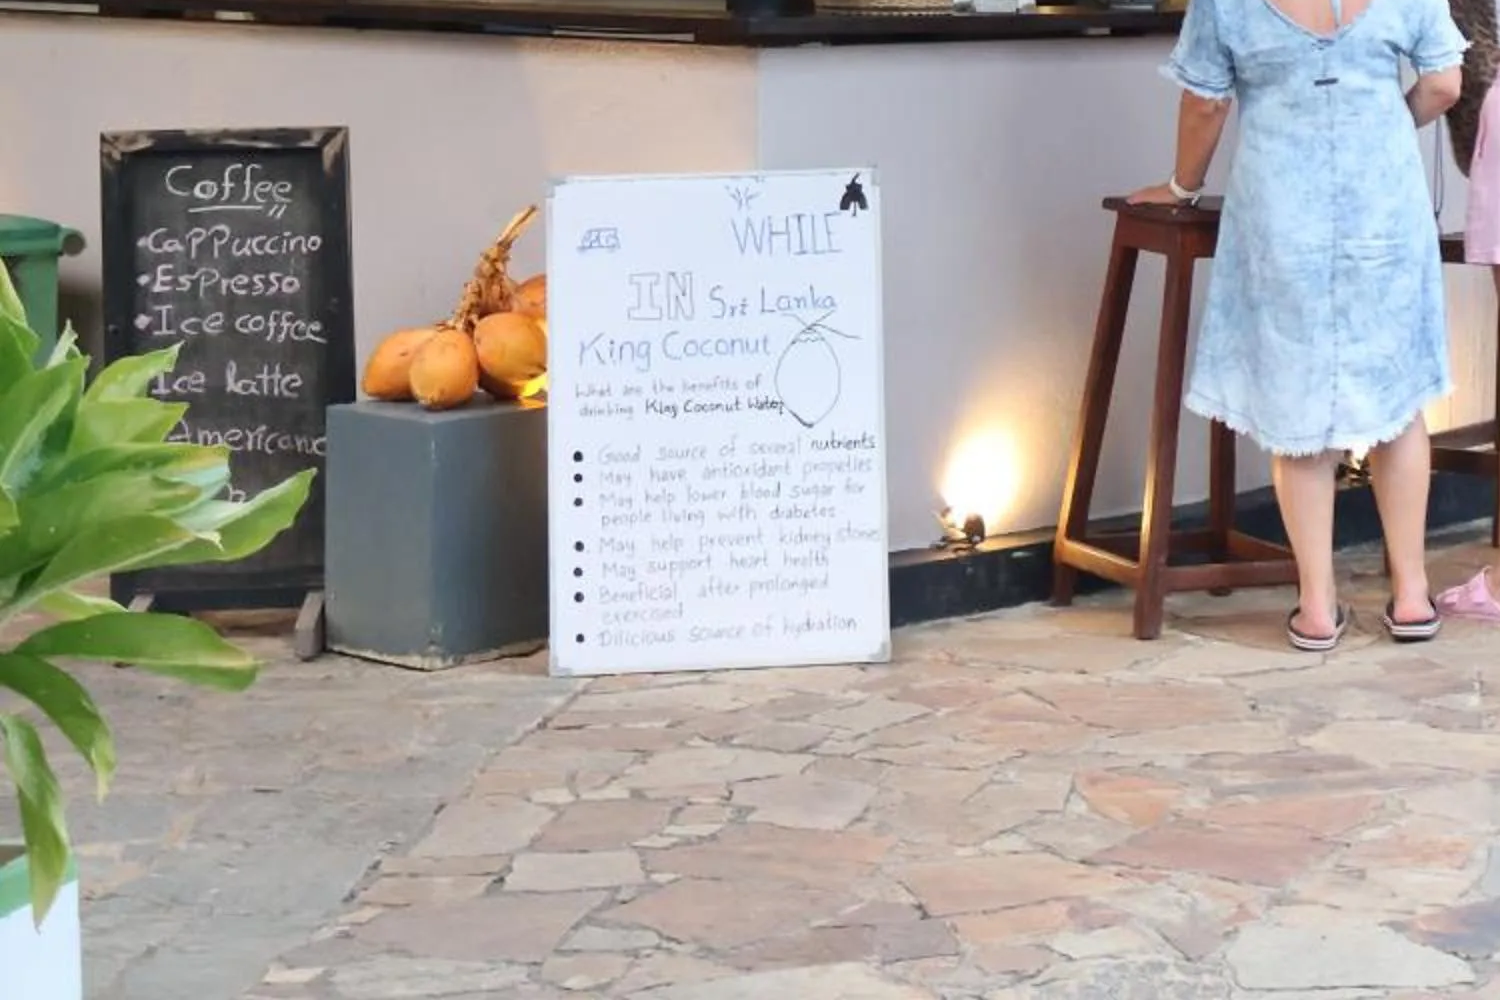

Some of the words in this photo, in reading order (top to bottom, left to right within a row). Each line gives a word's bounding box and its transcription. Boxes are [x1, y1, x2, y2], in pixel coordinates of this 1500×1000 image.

[165, 163, 293, 202] Coffee
[730, 211, 843, 256] WHILE
[628, 271, 696, 321] IN
[709, 285, 749, 319] Sri
[761, 285, 837, 314] Lanka
[152, 304, 225, 336] Ice
[235, 310, 328, 343] coffee
[579, 332, 651, 371] King
[664, 331, 771, 361] Coconut
[150, 369, 207, 395] Ice
[652, 378, 674, 395] the
[745, 373, 762, 390] of
[645, 398, 678, 418] King
[683, 396, 741, 413] Coconut
[598, 444, 641, 465] Good
[655, 445, 707, 461] source
[718, 434, 738, 457] of
[810, 430, 876, 450] nutrients
[599, 469, 631, 486] May
[650, 466, 686, 483] have
[702, 459, 791, 481] antioxidant
[599, 491, 633, 509] May
[645, 487, 675, 507] help
[687, 485, 726, 503] lower
[741, 481, 781, 500] blood
[789, 484, 836, 503] sugar
[601, 510, 652, 529] people
[661, 508, 705, 527] living
[718, 504, 757, 521] with
[769, 502, 836, 520] diabetes
[599, 537, 635, 556] May
[651, 533, 684, 552] help
[699, 527, 763, 554] prevent
[779, 525, 831, 550] kidney
[602, 562, 636, 581] May
[647, 555, 711, 579] support
[730, 549, 768, 569] heart
[783, 548, 828, 567] health
[599, 582, 677, 604] Beneficial
[698, 576, 740, 598] after
[749, 574, 828, 599] prolonged
[782, 611, 858, 638] hydration
